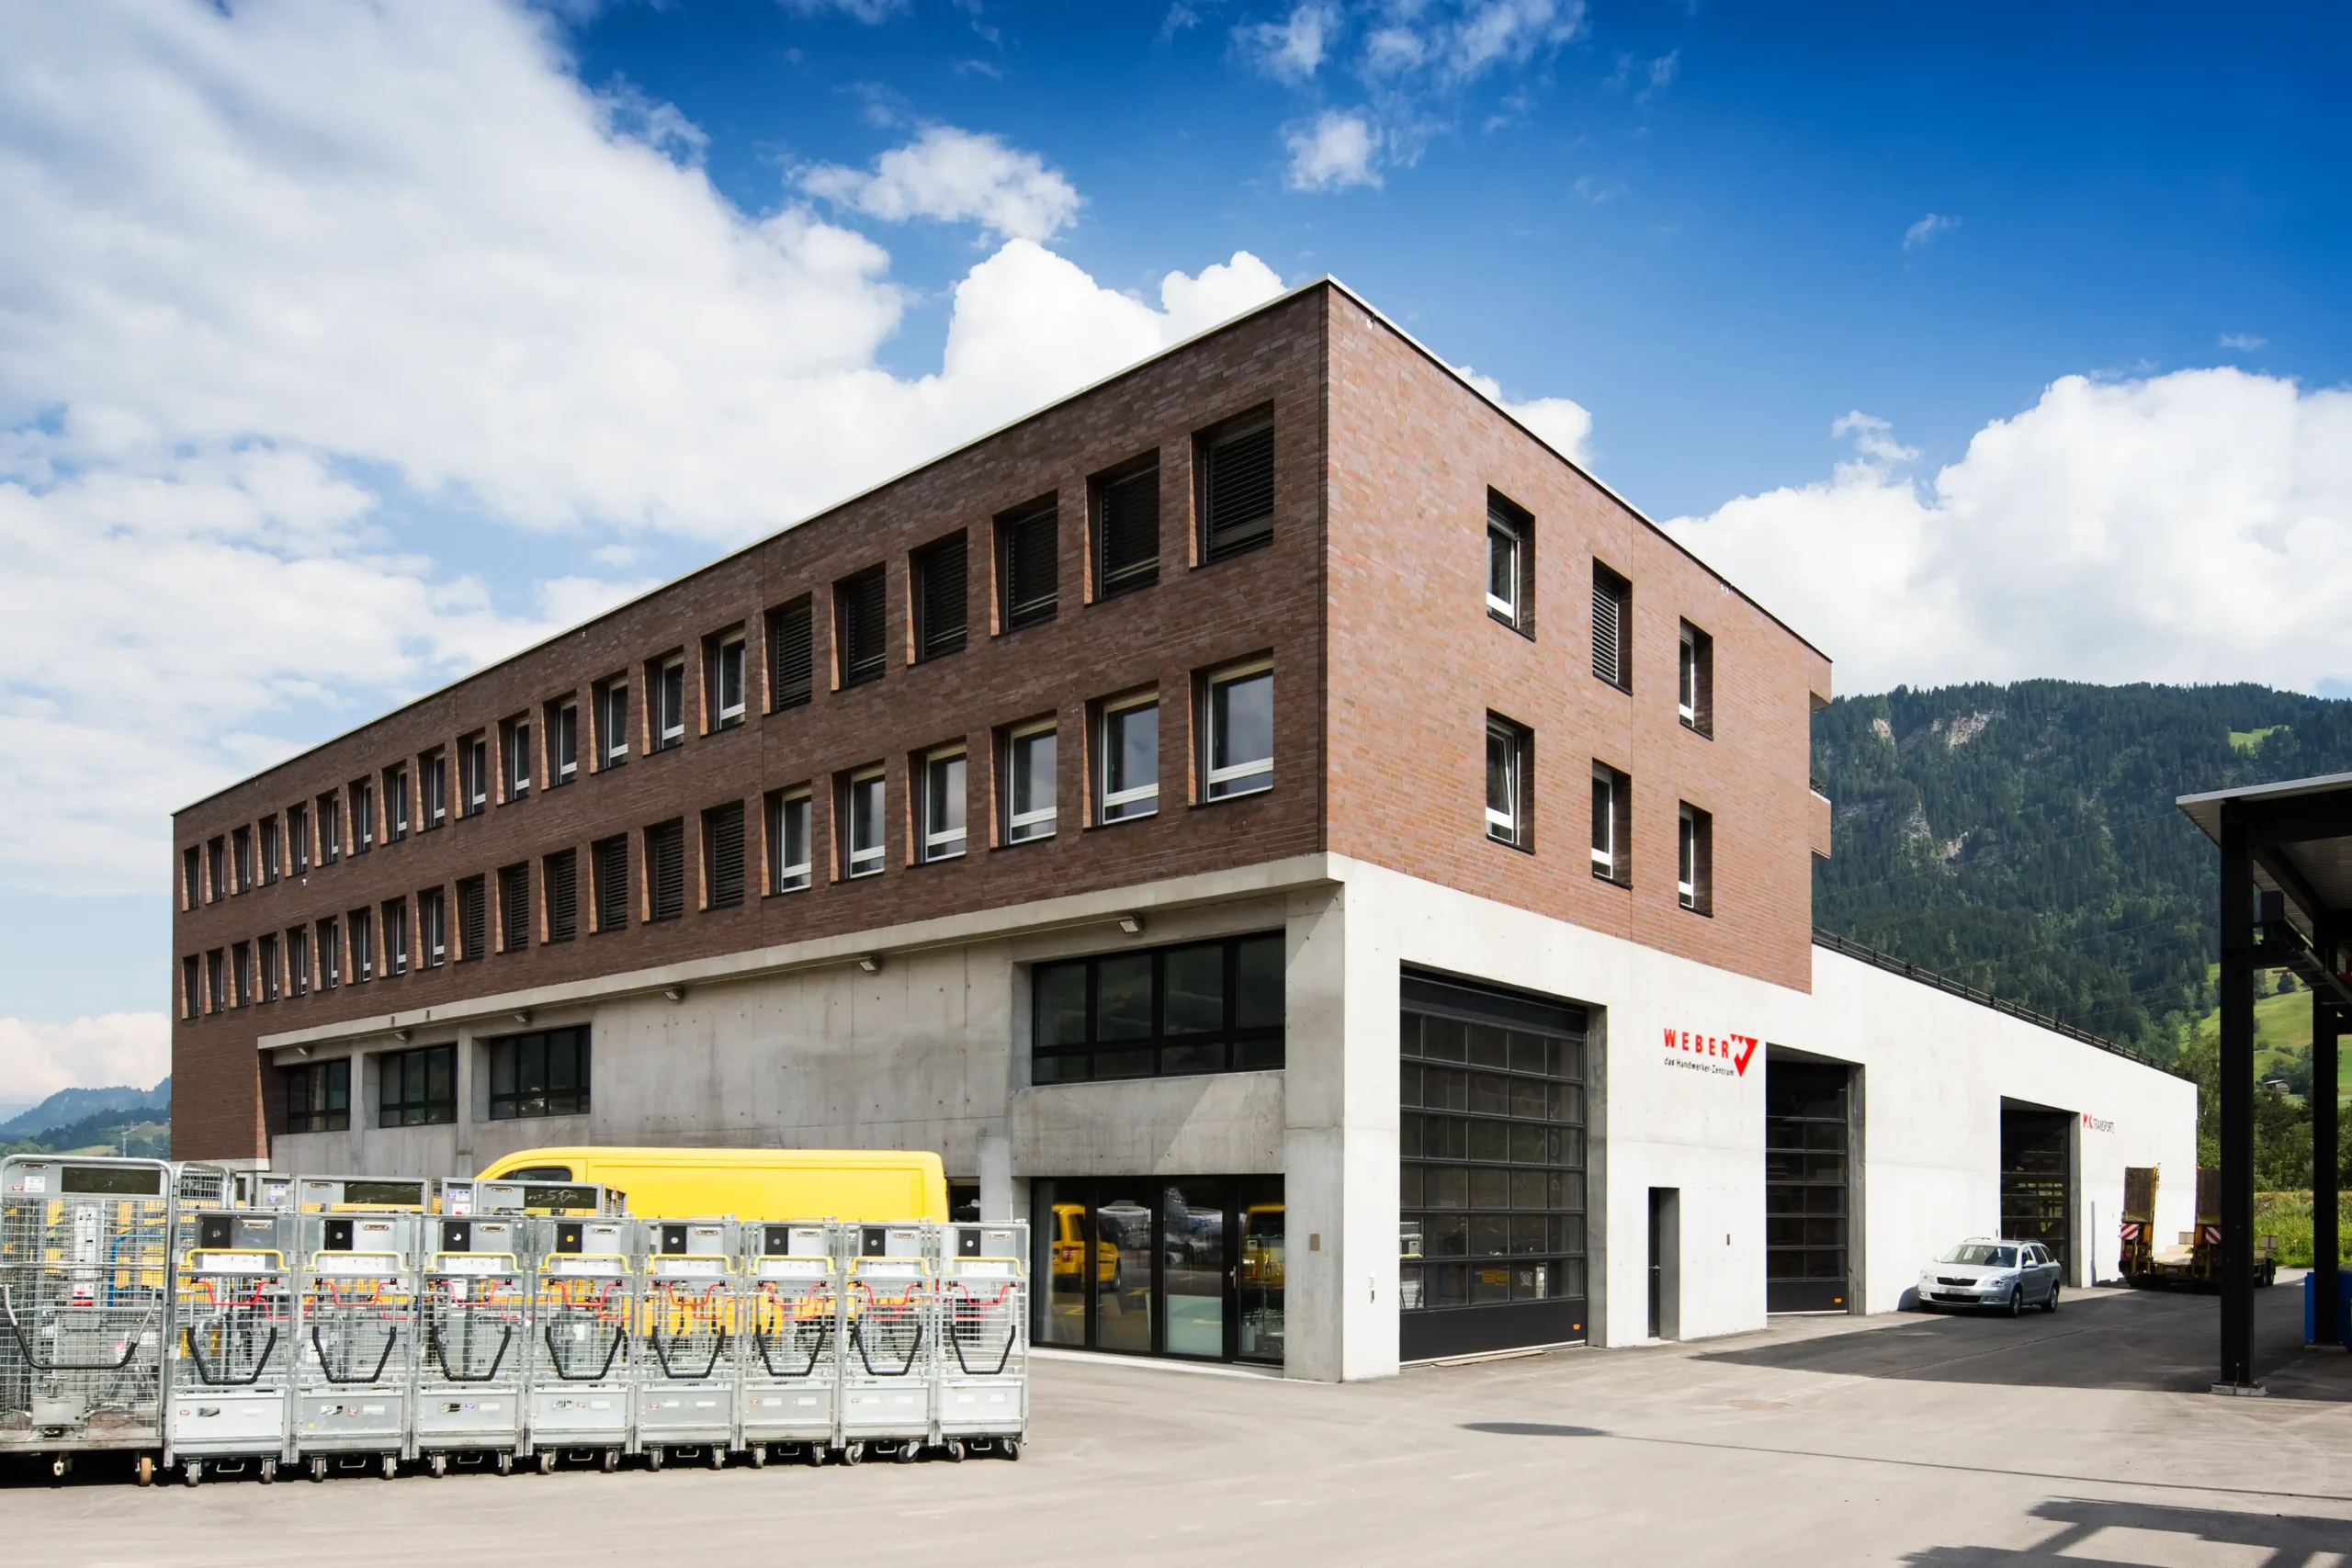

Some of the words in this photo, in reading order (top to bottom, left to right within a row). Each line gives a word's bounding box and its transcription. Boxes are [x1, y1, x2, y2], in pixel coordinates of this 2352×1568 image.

[1664, 1028, 1729, 1058] WEBER
[1664, 1056, 1675, 1066] das
[1676, 1058, 1735, 1077] Handwerker-Zentrum
